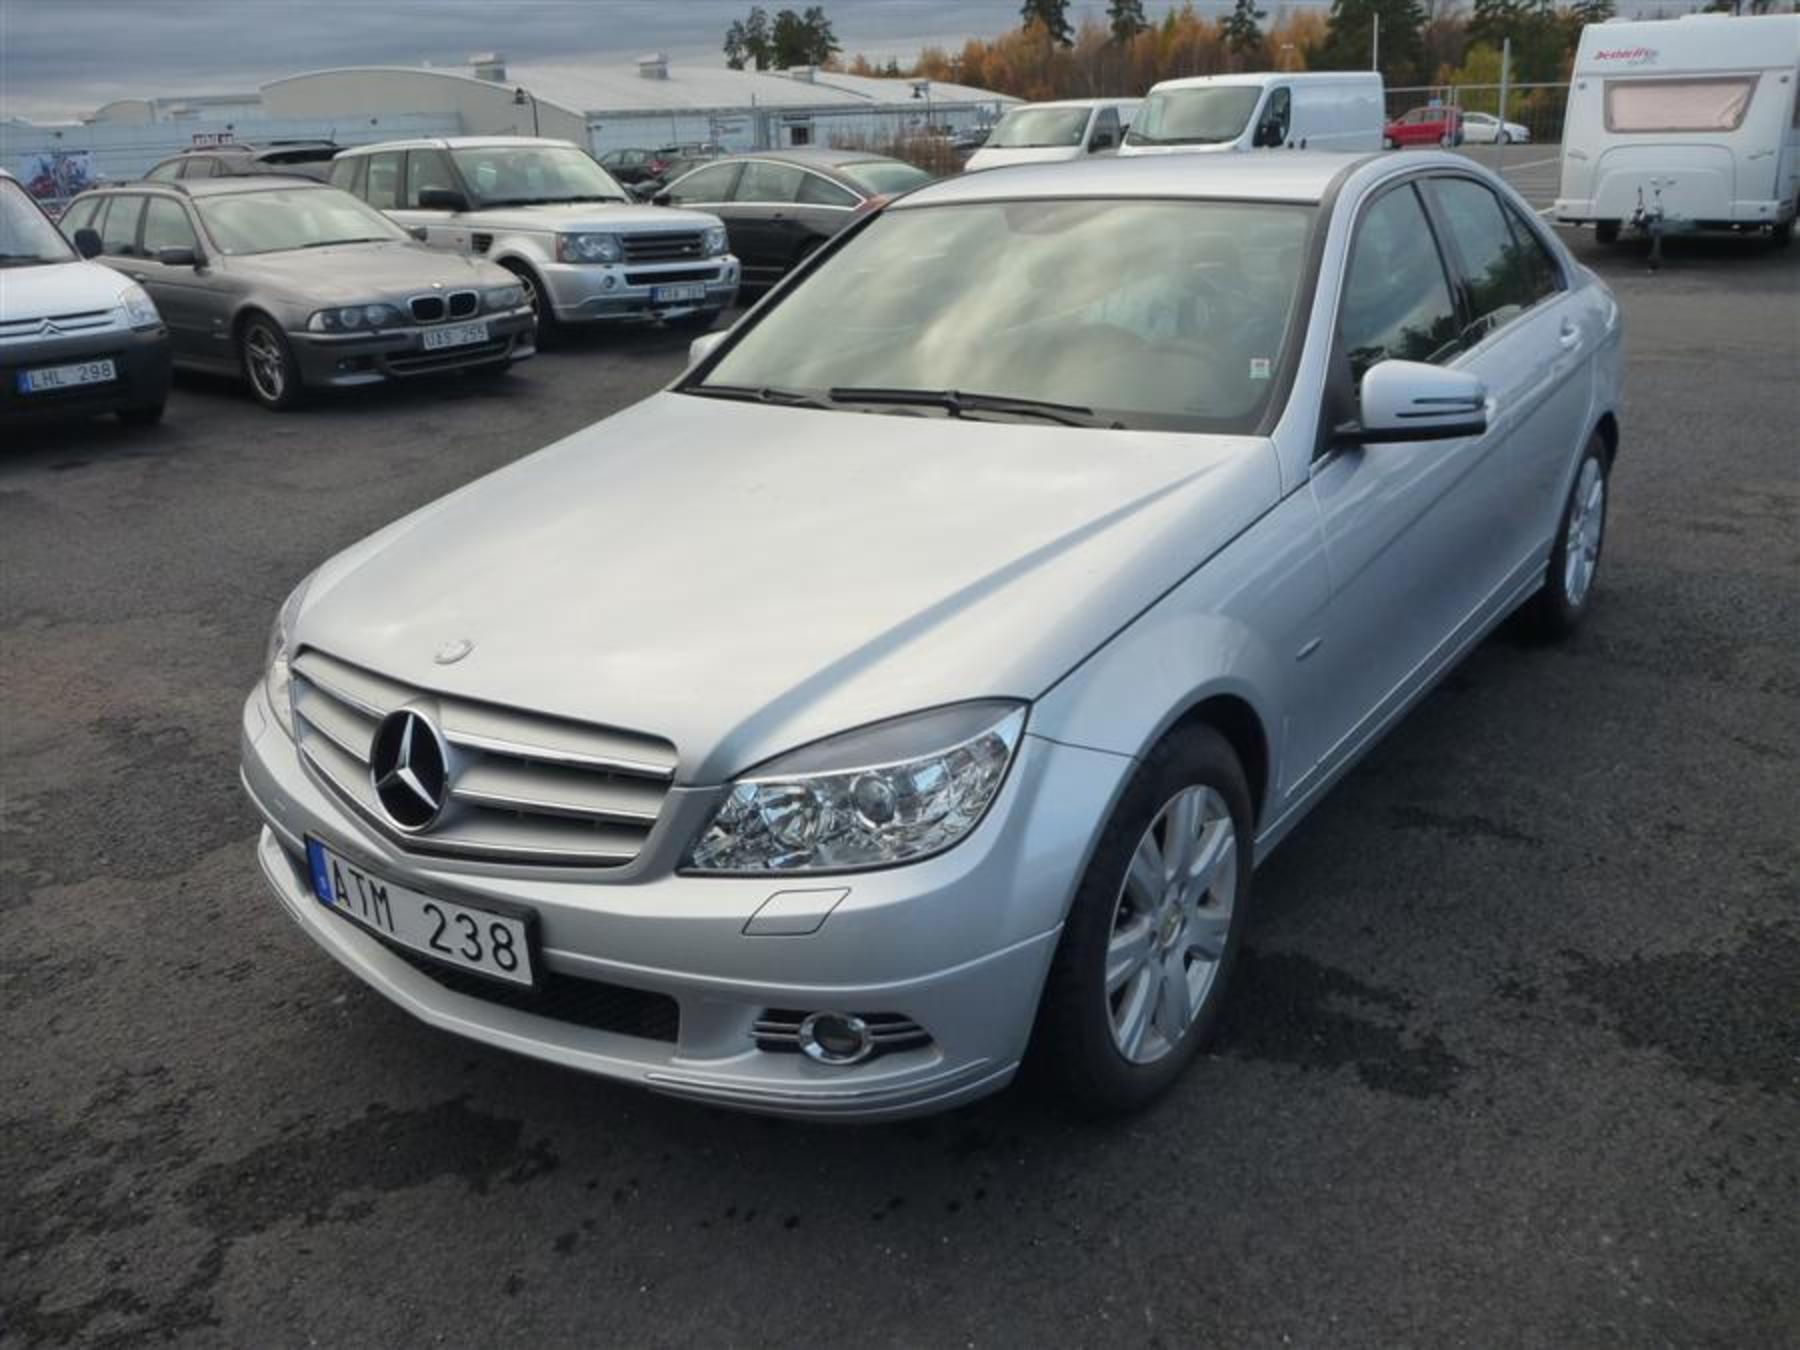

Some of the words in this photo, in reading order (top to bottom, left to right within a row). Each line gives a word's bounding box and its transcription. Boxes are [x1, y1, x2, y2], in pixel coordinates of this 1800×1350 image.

[32, 370, 64, 388] LHL
[78, 363, 112, 381] 298
[332, 859, 395, 932] ATM
[423, 903, 518, 971] 238
